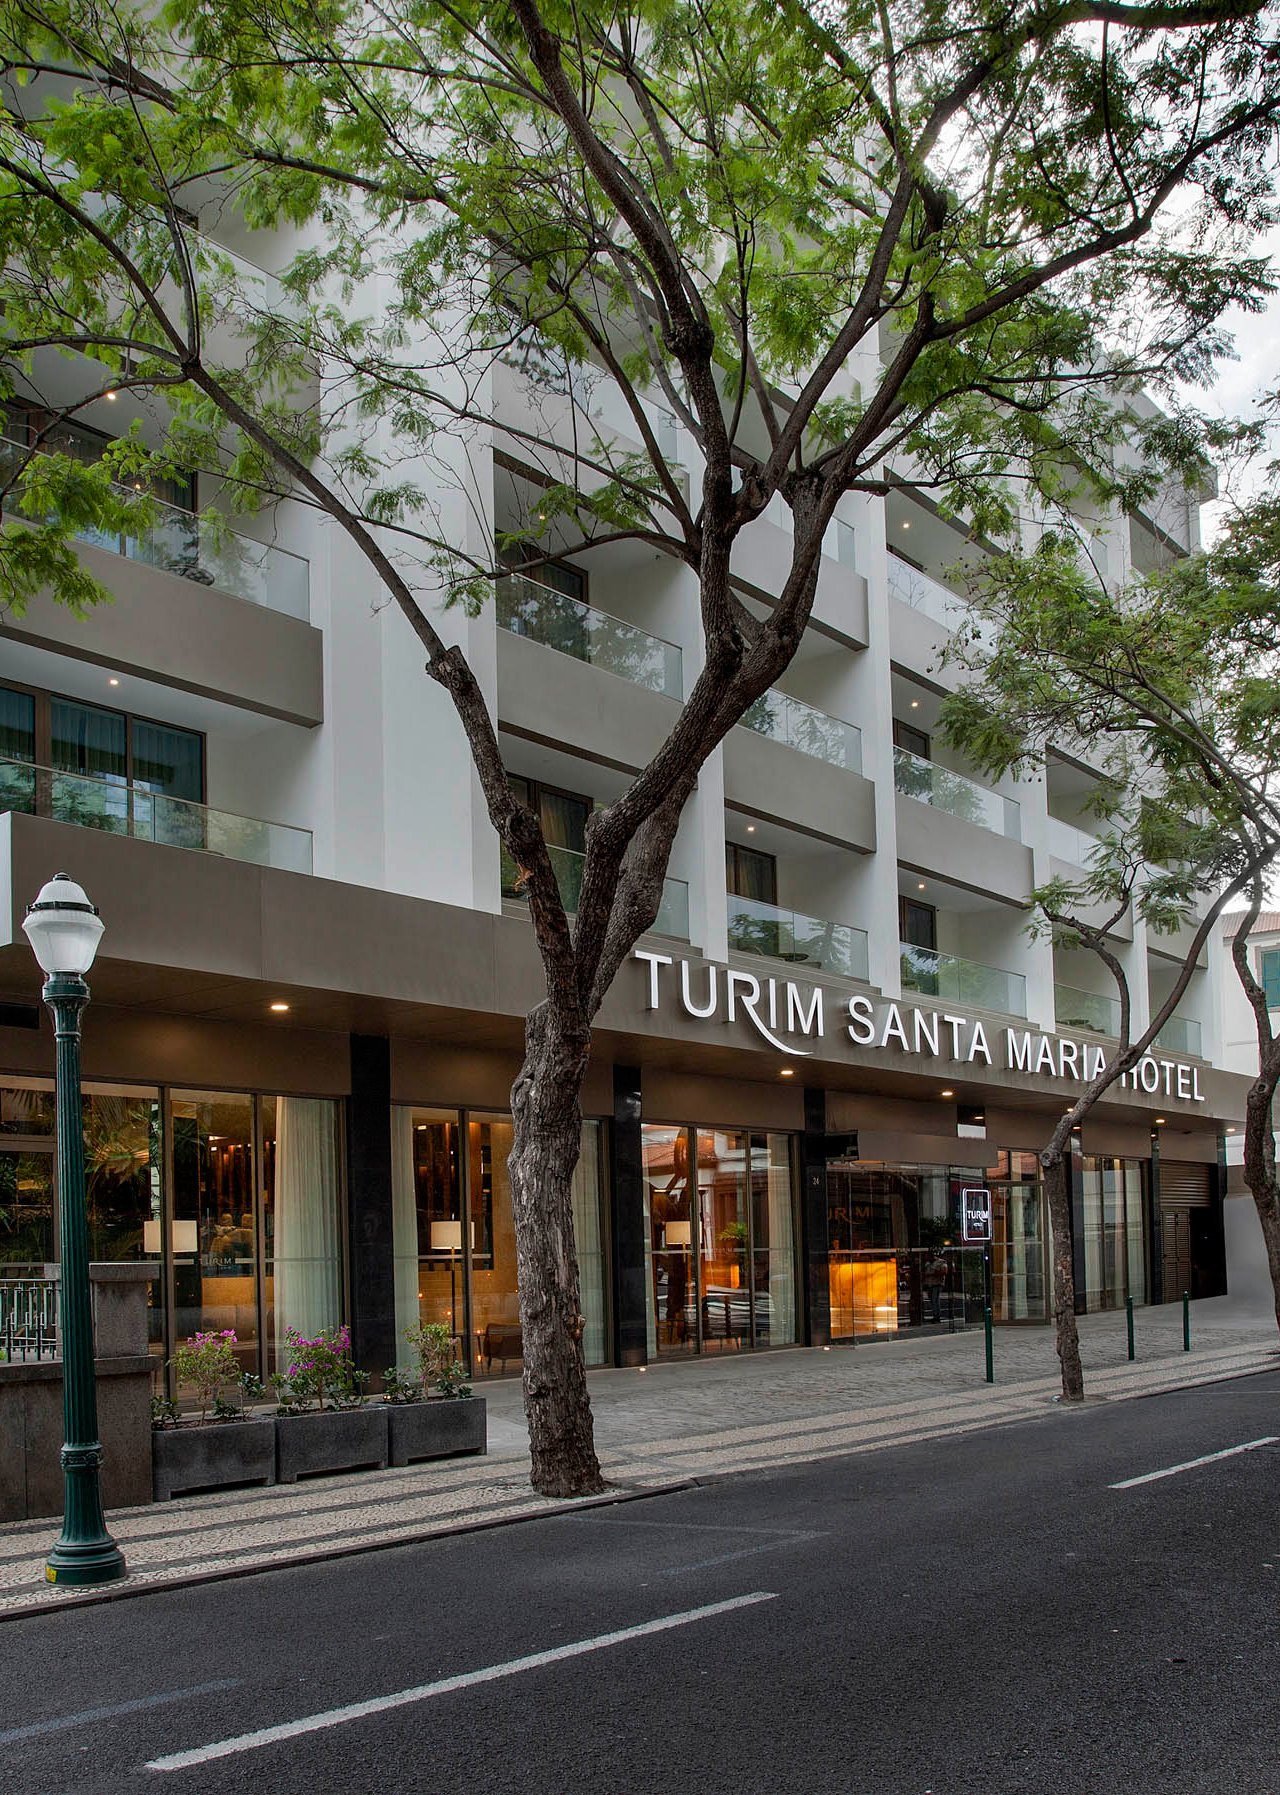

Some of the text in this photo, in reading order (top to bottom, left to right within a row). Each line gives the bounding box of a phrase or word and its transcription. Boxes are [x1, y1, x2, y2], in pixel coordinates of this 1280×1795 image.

[634, 950, 824, 1056] TURIM
[848, 995, 992, 1065] SANTA
[1006, 1027, 1107, 1082] MARIA
[812, 1176, 820, 1185] 24
